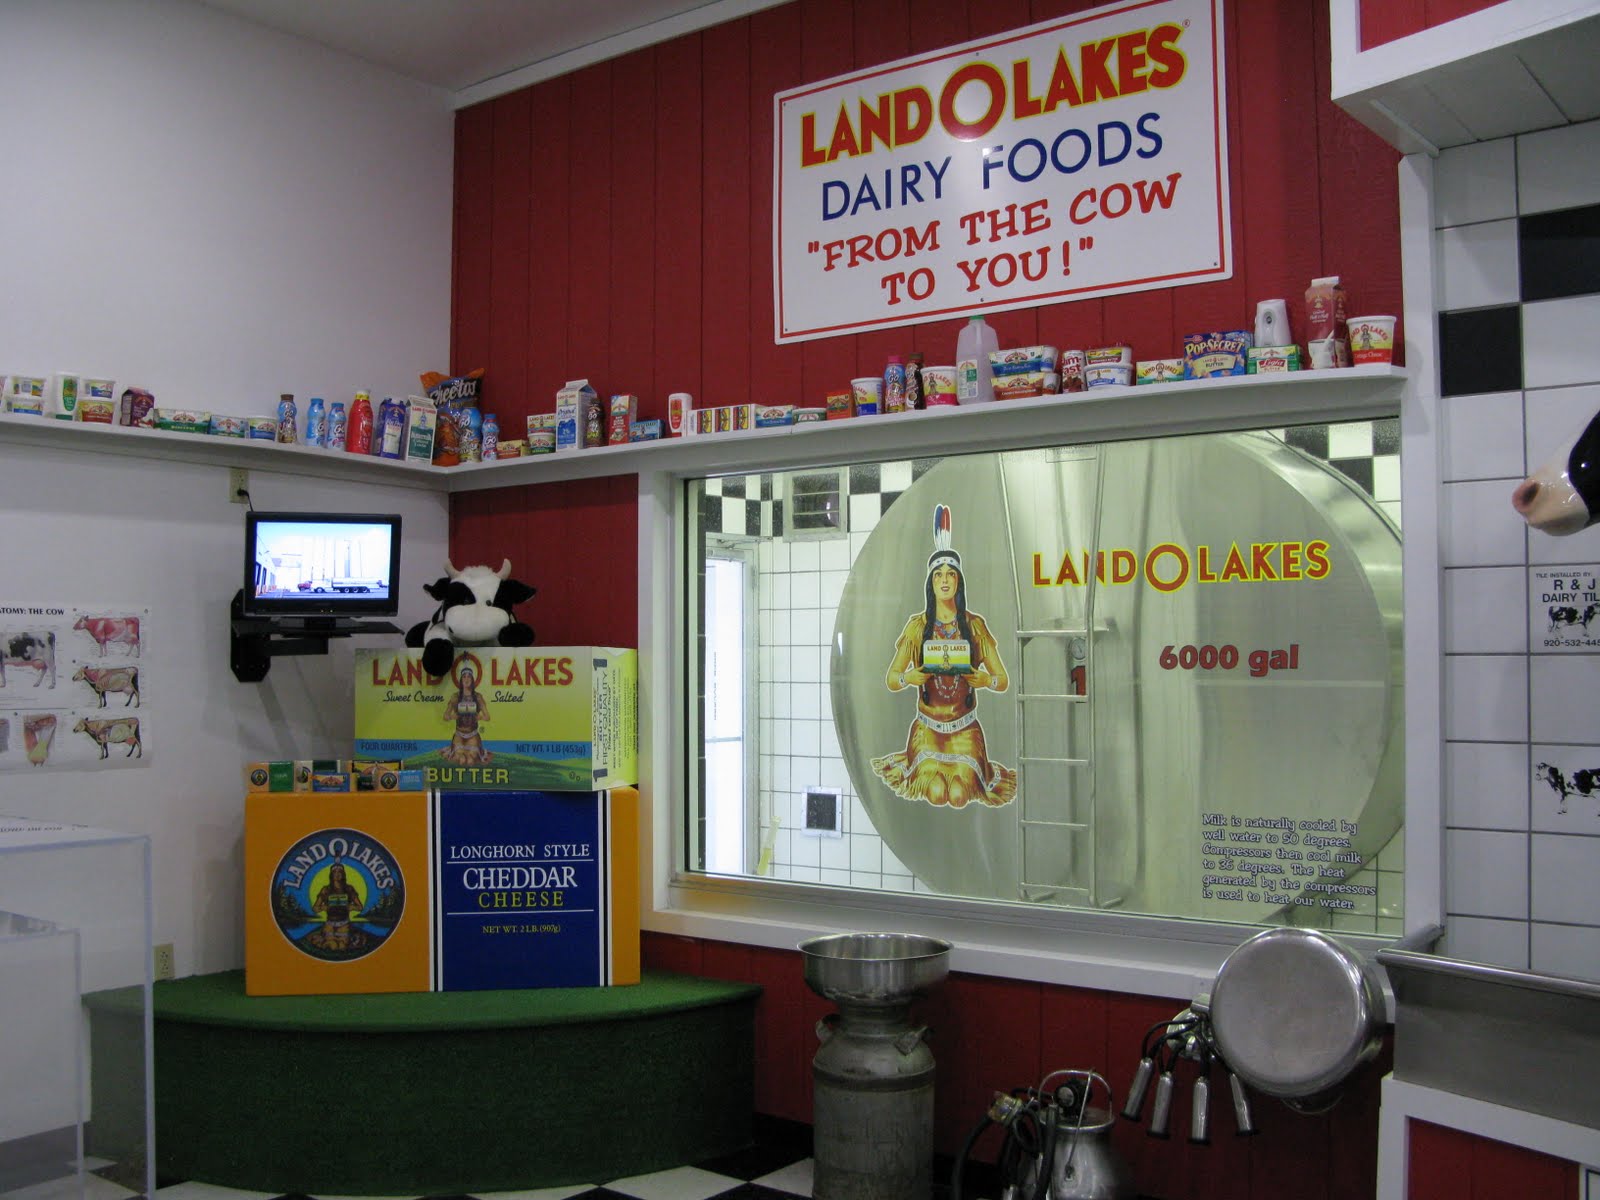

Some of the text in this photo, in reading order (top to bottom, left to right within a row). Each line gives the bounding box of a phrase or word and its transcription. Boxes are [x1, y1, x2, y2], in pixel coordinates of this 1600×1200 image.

[823, 112, 1163, 221] DAIRY FOODS
[807, 172, 1182, 272] "FROM THE COW
[881, 268, 935, 306] TO
[1185, 339, 1243, 355] POP-SECRET
[430, 379, 476, 406] Cheetos
[1553, 578, 1596, 591] R & J
[1542, 593, 1578, 603] DAIRY
[28, 607, 44, 615] THE
[46, 608, 65, 616] COW
[1159, 644, 1299, 678] 6000 gal
[491, 657, 574, 687] LAKES
[383, 690, 525, 703] Sweet Cream Salted
[361, 742, 418, 751] FOUR QUARTERS
[516, 743, 531, 753] NET
[551, 744, 561, 753] LB
[427, 767, 510, 784] BUTTER
[1202, 814, 1357, 835] Milk is naturally cooled by
[1203, 830, 1225, 841] well
[1230, 833, 1261, 843] water
[1266, 833, 1279, 843] to
[1303, 835, 1351, 849] degrees.
[451, 844, 590, 859] LONGHORN STYLE
[1202, 844, 1362, 864] Compressors then cool milk
[463, 866, 578, 890] CHEDDAR
[1203, 859, 1345, 878] to 36 degrees. The heat
[1202, 874, 1377, 896] generated by the compressors
[478, 891, 564, 908] CHEESE
[1203, 888, 1354, 910] is used to heat our water.
[482, 925, 500, 933] NET
[520, 925, 525, 933] 2
[539, 924, 561, 934] (907g)
